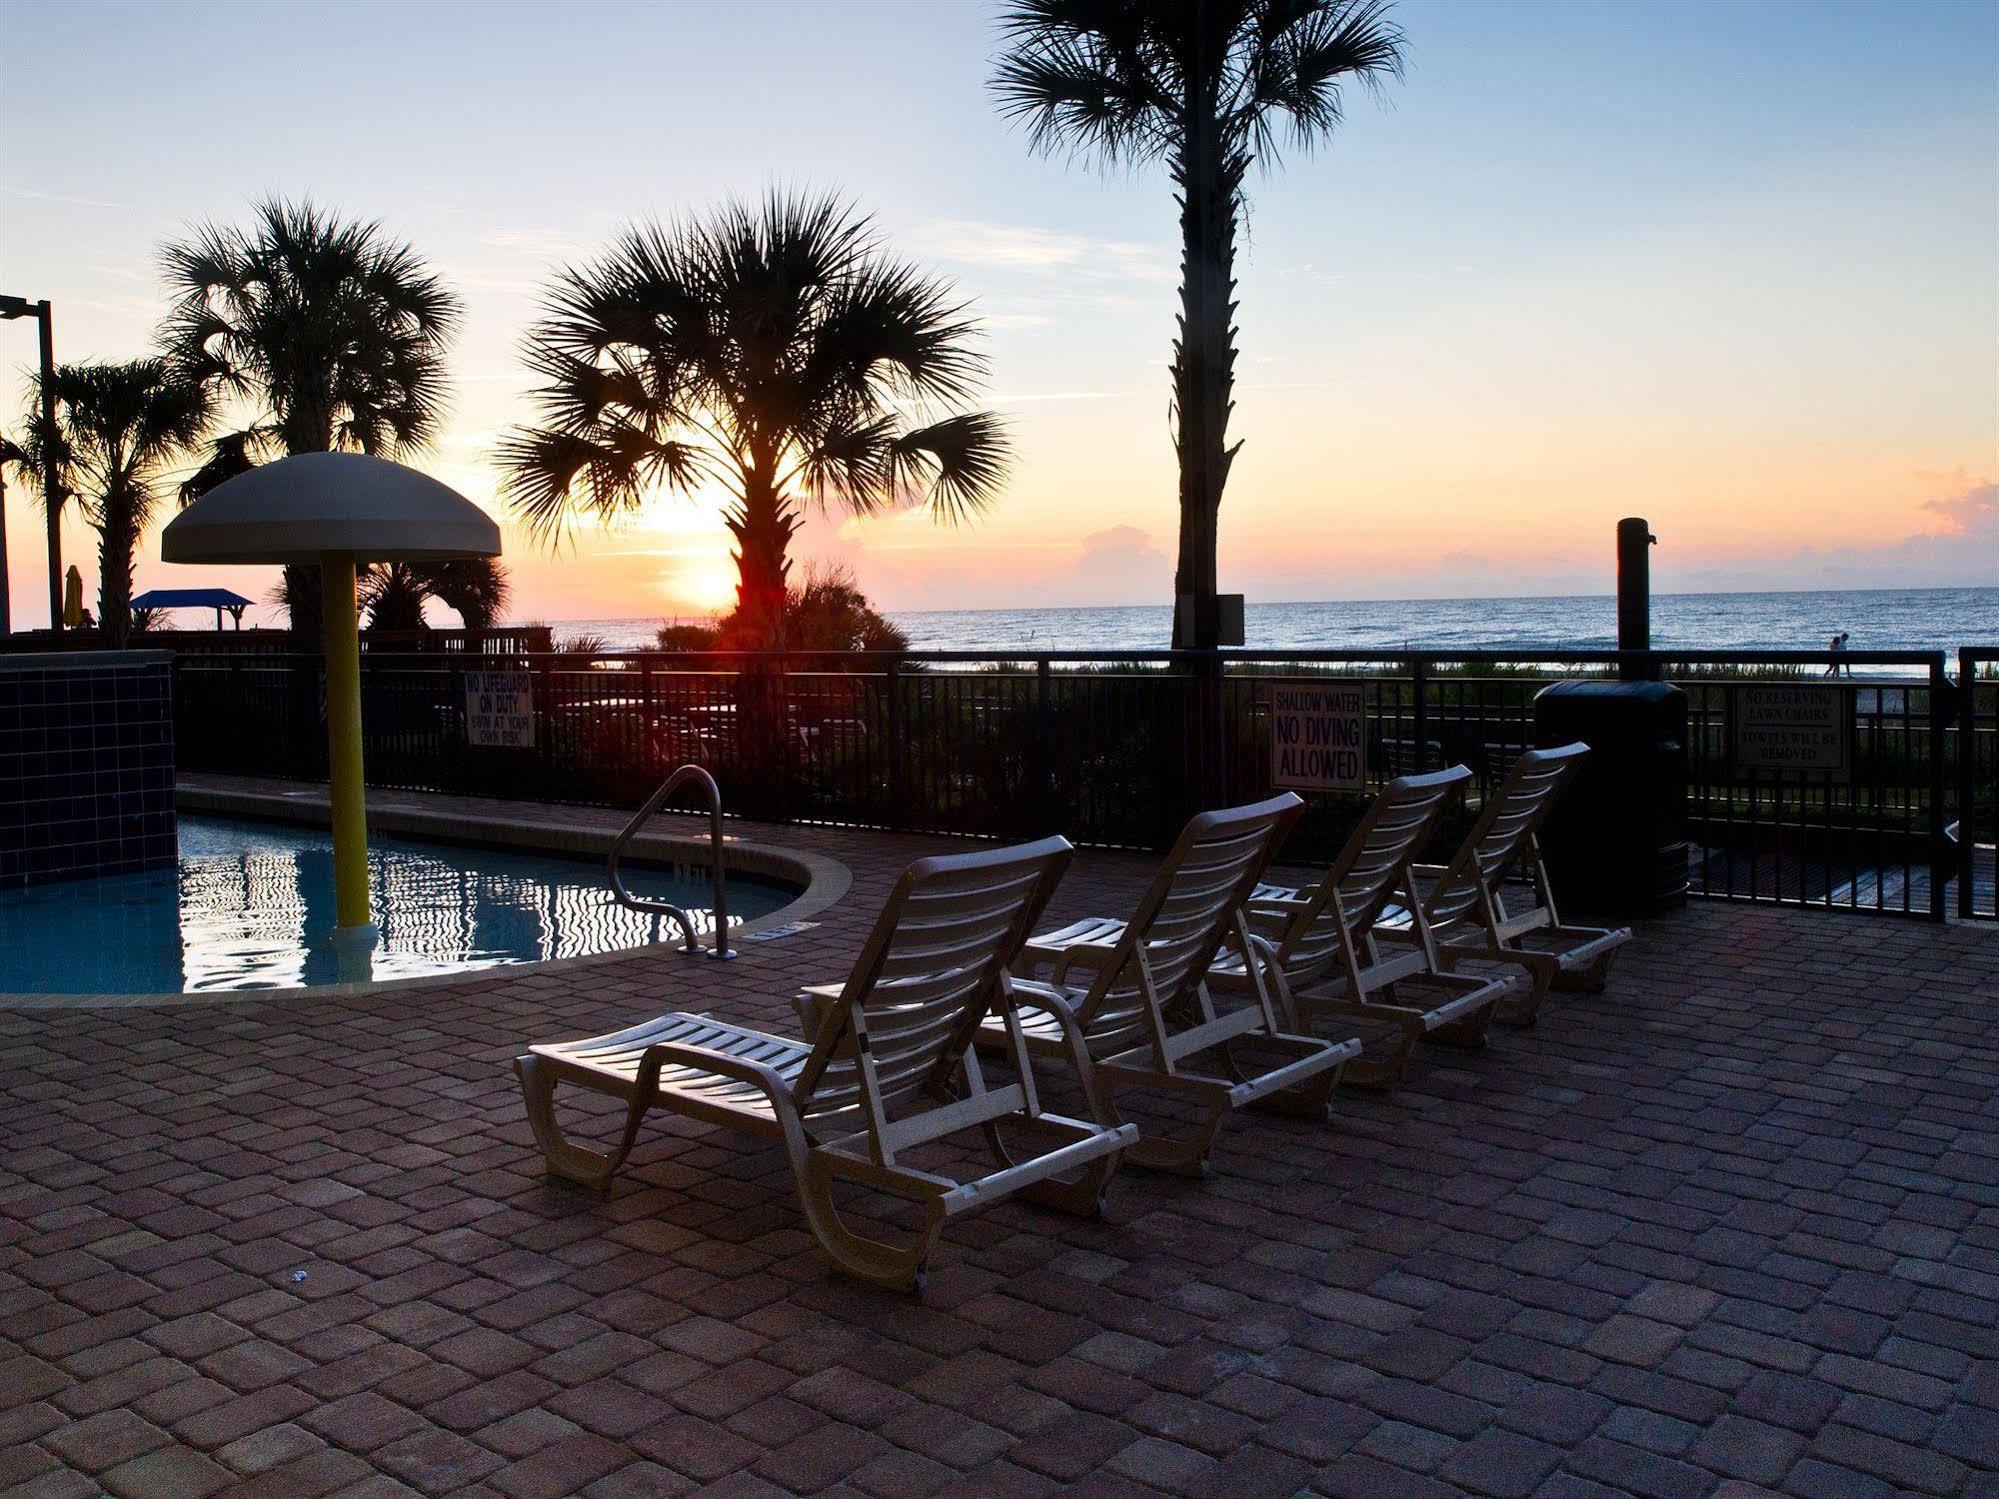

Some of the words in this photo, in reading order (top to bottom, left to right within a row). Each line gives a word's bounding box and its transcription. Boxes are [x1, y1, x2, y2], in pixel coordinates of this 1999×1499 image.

[467, 672, 479, 693] NO
[482, 672, 529, 694] LIFEGUARD
[480, 694, 492, 713] ON
[496, 694, 518, 714] DUTY
[1276, 691, 1322, 711] SHALLOW
[1325, 692, 1361, 713] WATER
[1745, 689, 1761, 705] NO
[471, 714, 491, 729] SWIM
[495, 715, 505, 730] AT
[508, 715, 529, 730] YOUR
[1277, 716, 1299, 745] NO
[1306, 717, 1360, 748] DIVING
[480, 730, 498, 744] OWN
[502, 730, 520, 745] RISK
[1280, 748, 1358, 780] ALLOWED
